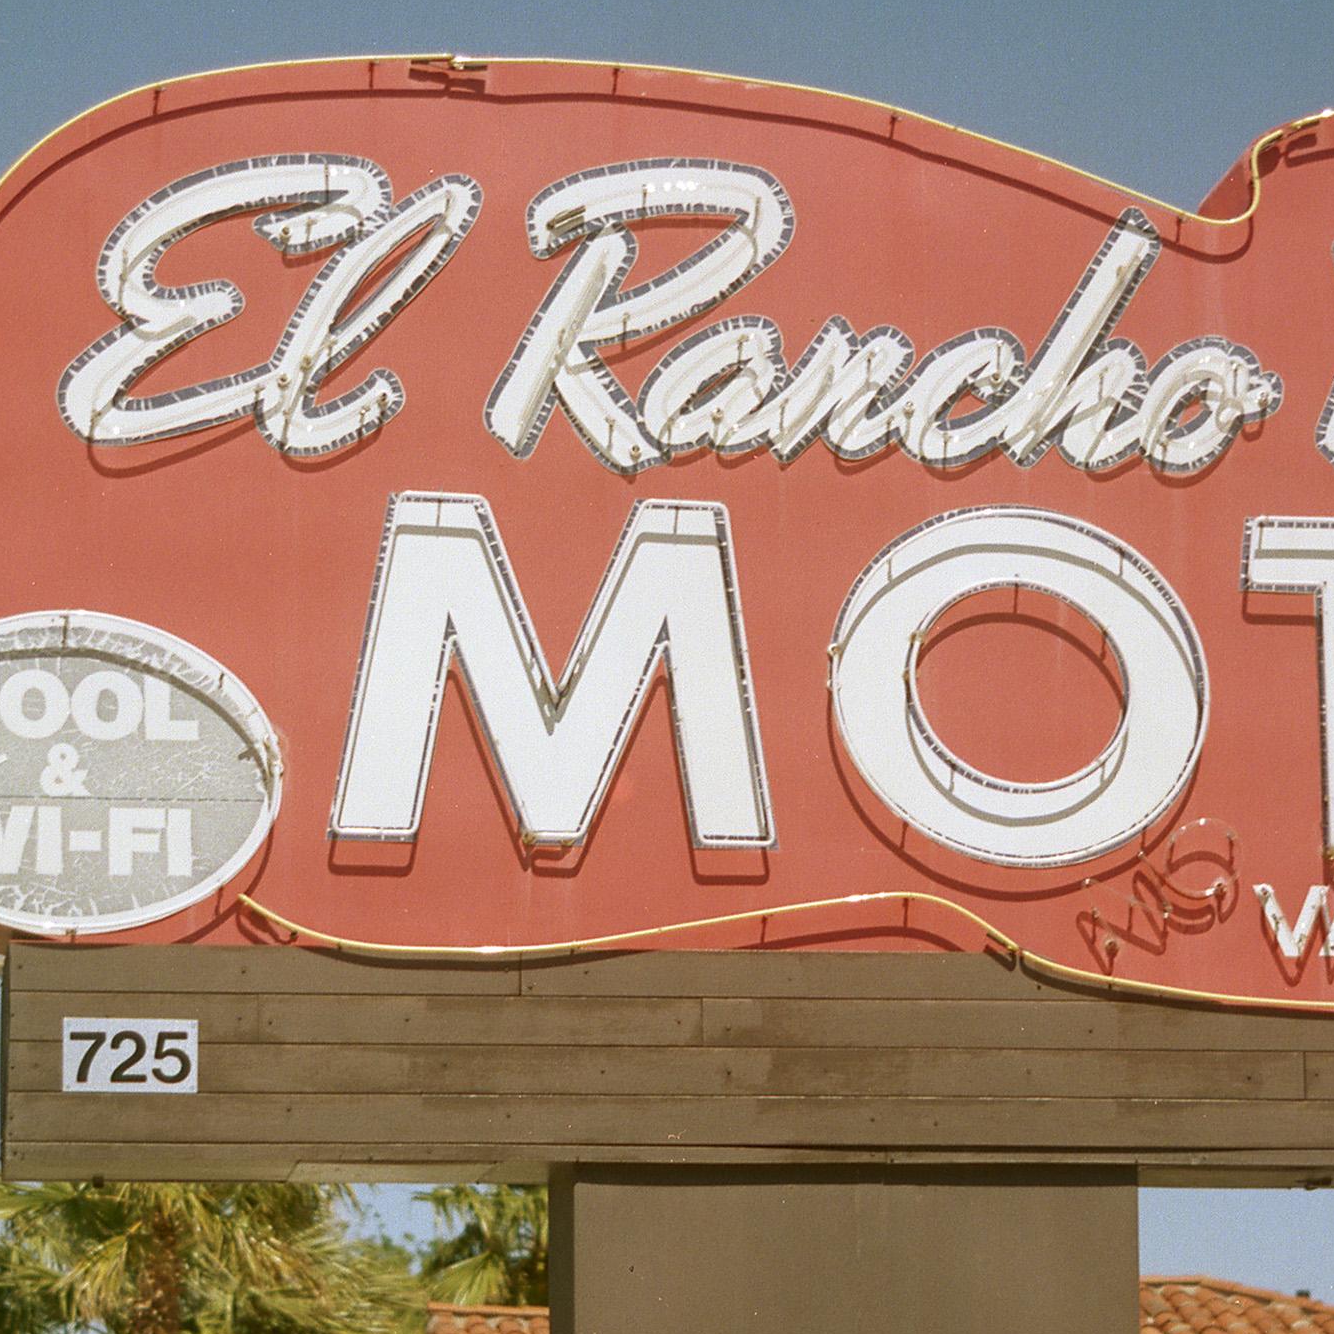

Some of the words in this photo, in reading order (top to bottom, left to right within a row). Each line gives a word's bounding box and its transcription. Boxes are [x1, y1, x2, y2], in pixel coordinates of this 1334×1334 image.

[56, 153, 486, 460] El
[482, 155, 1284, 473] Rancho
[39, 743, 90, 798] &
[69, 1030, 192, 1085] 725
